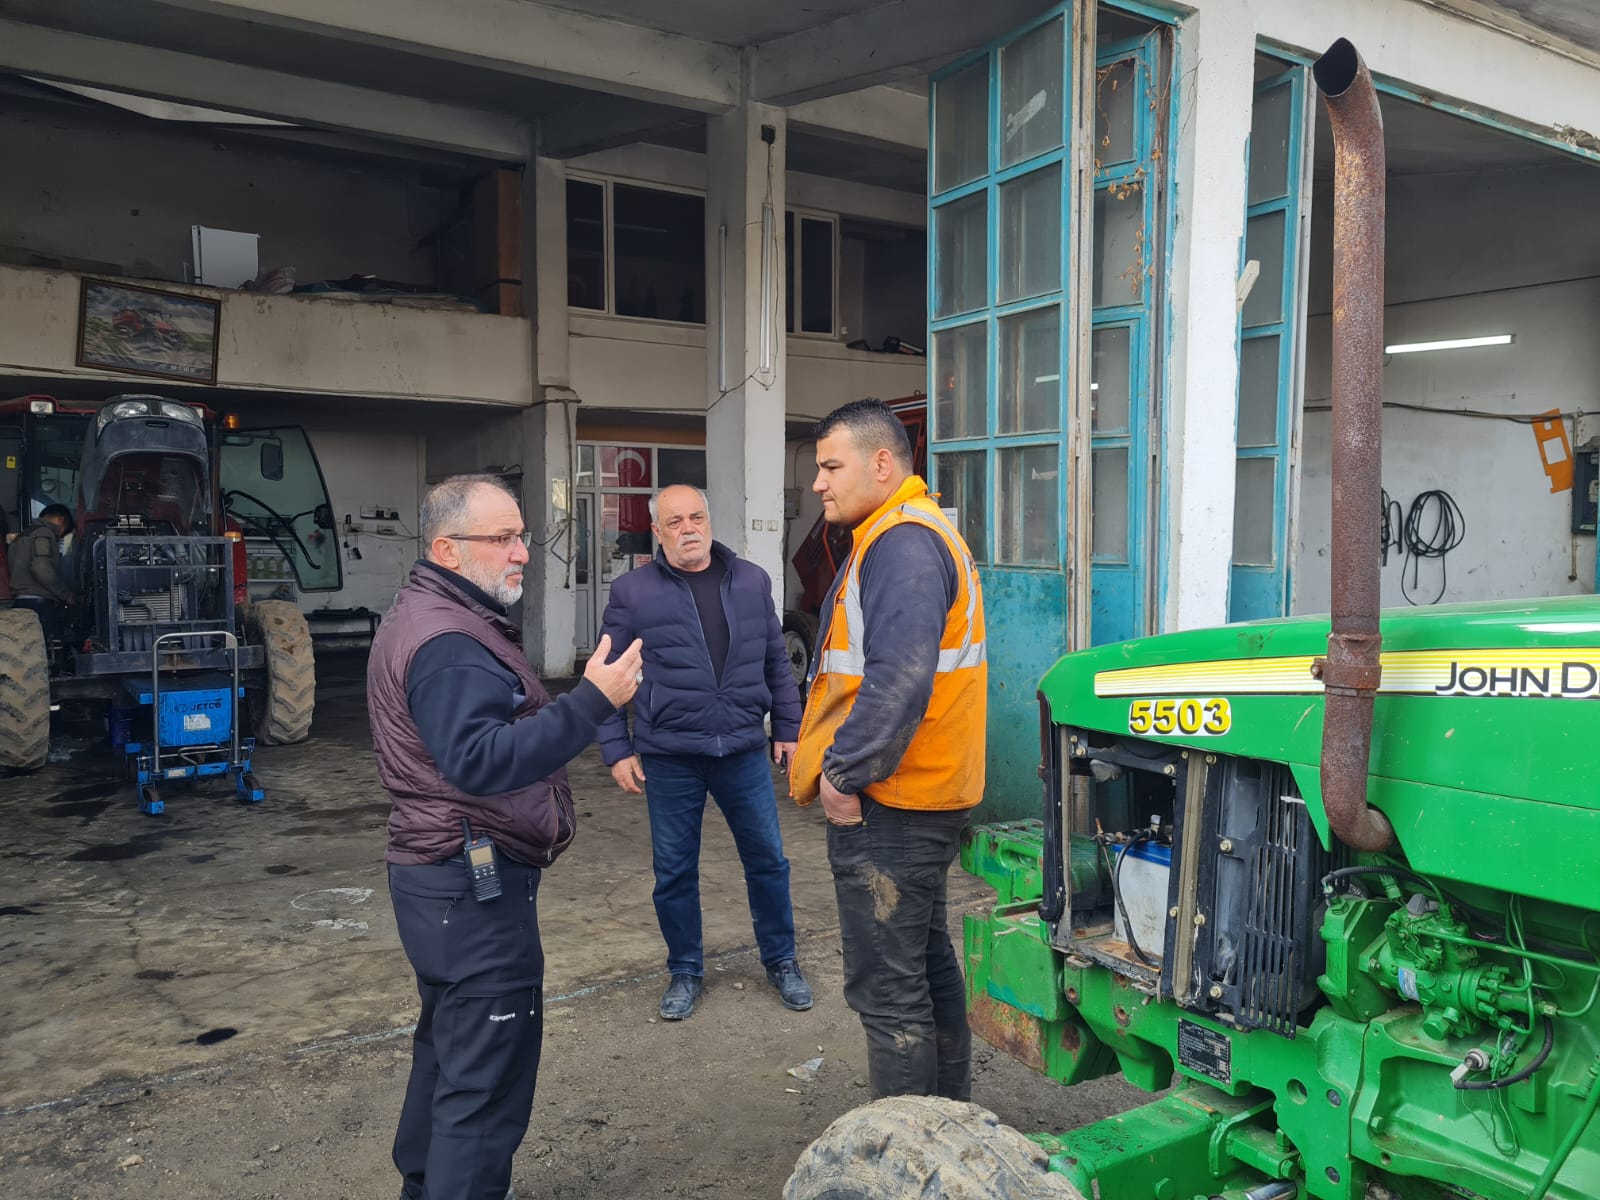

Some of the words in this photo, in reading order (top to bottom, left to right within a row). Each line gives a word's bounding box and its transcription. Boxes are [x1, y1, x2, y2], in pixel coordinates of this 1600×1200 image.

[1435, 661, 1550, 693] JOHN
[1561, 661, 1600, 694] D
[191, 702, 222, 711] JETCO
[1130, 698, 1231, 735] 5503
